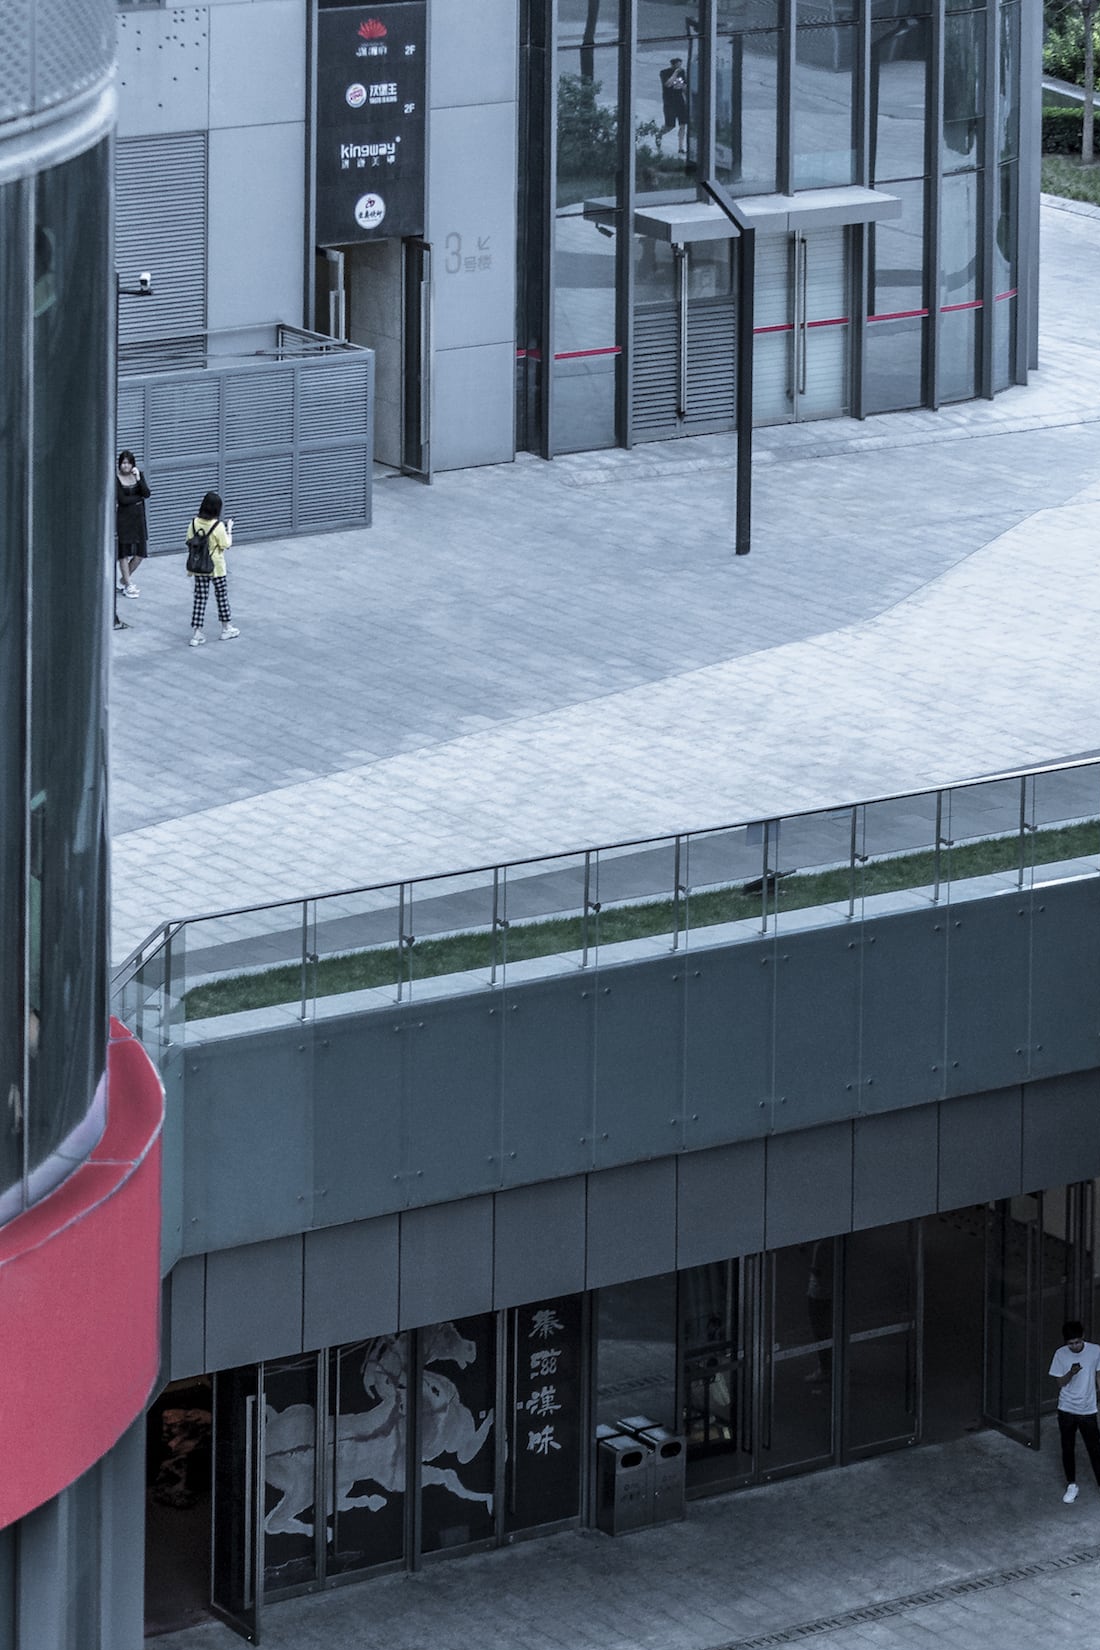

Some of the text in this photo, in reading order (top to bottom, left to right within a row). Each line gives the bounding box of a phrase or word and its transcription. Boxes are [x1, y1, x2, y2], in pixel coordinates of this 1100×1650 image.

[404, 44, 416, 56] 2F
[404, 103, 415, 114] 2F
[340, 142, 396, 159] kingway
